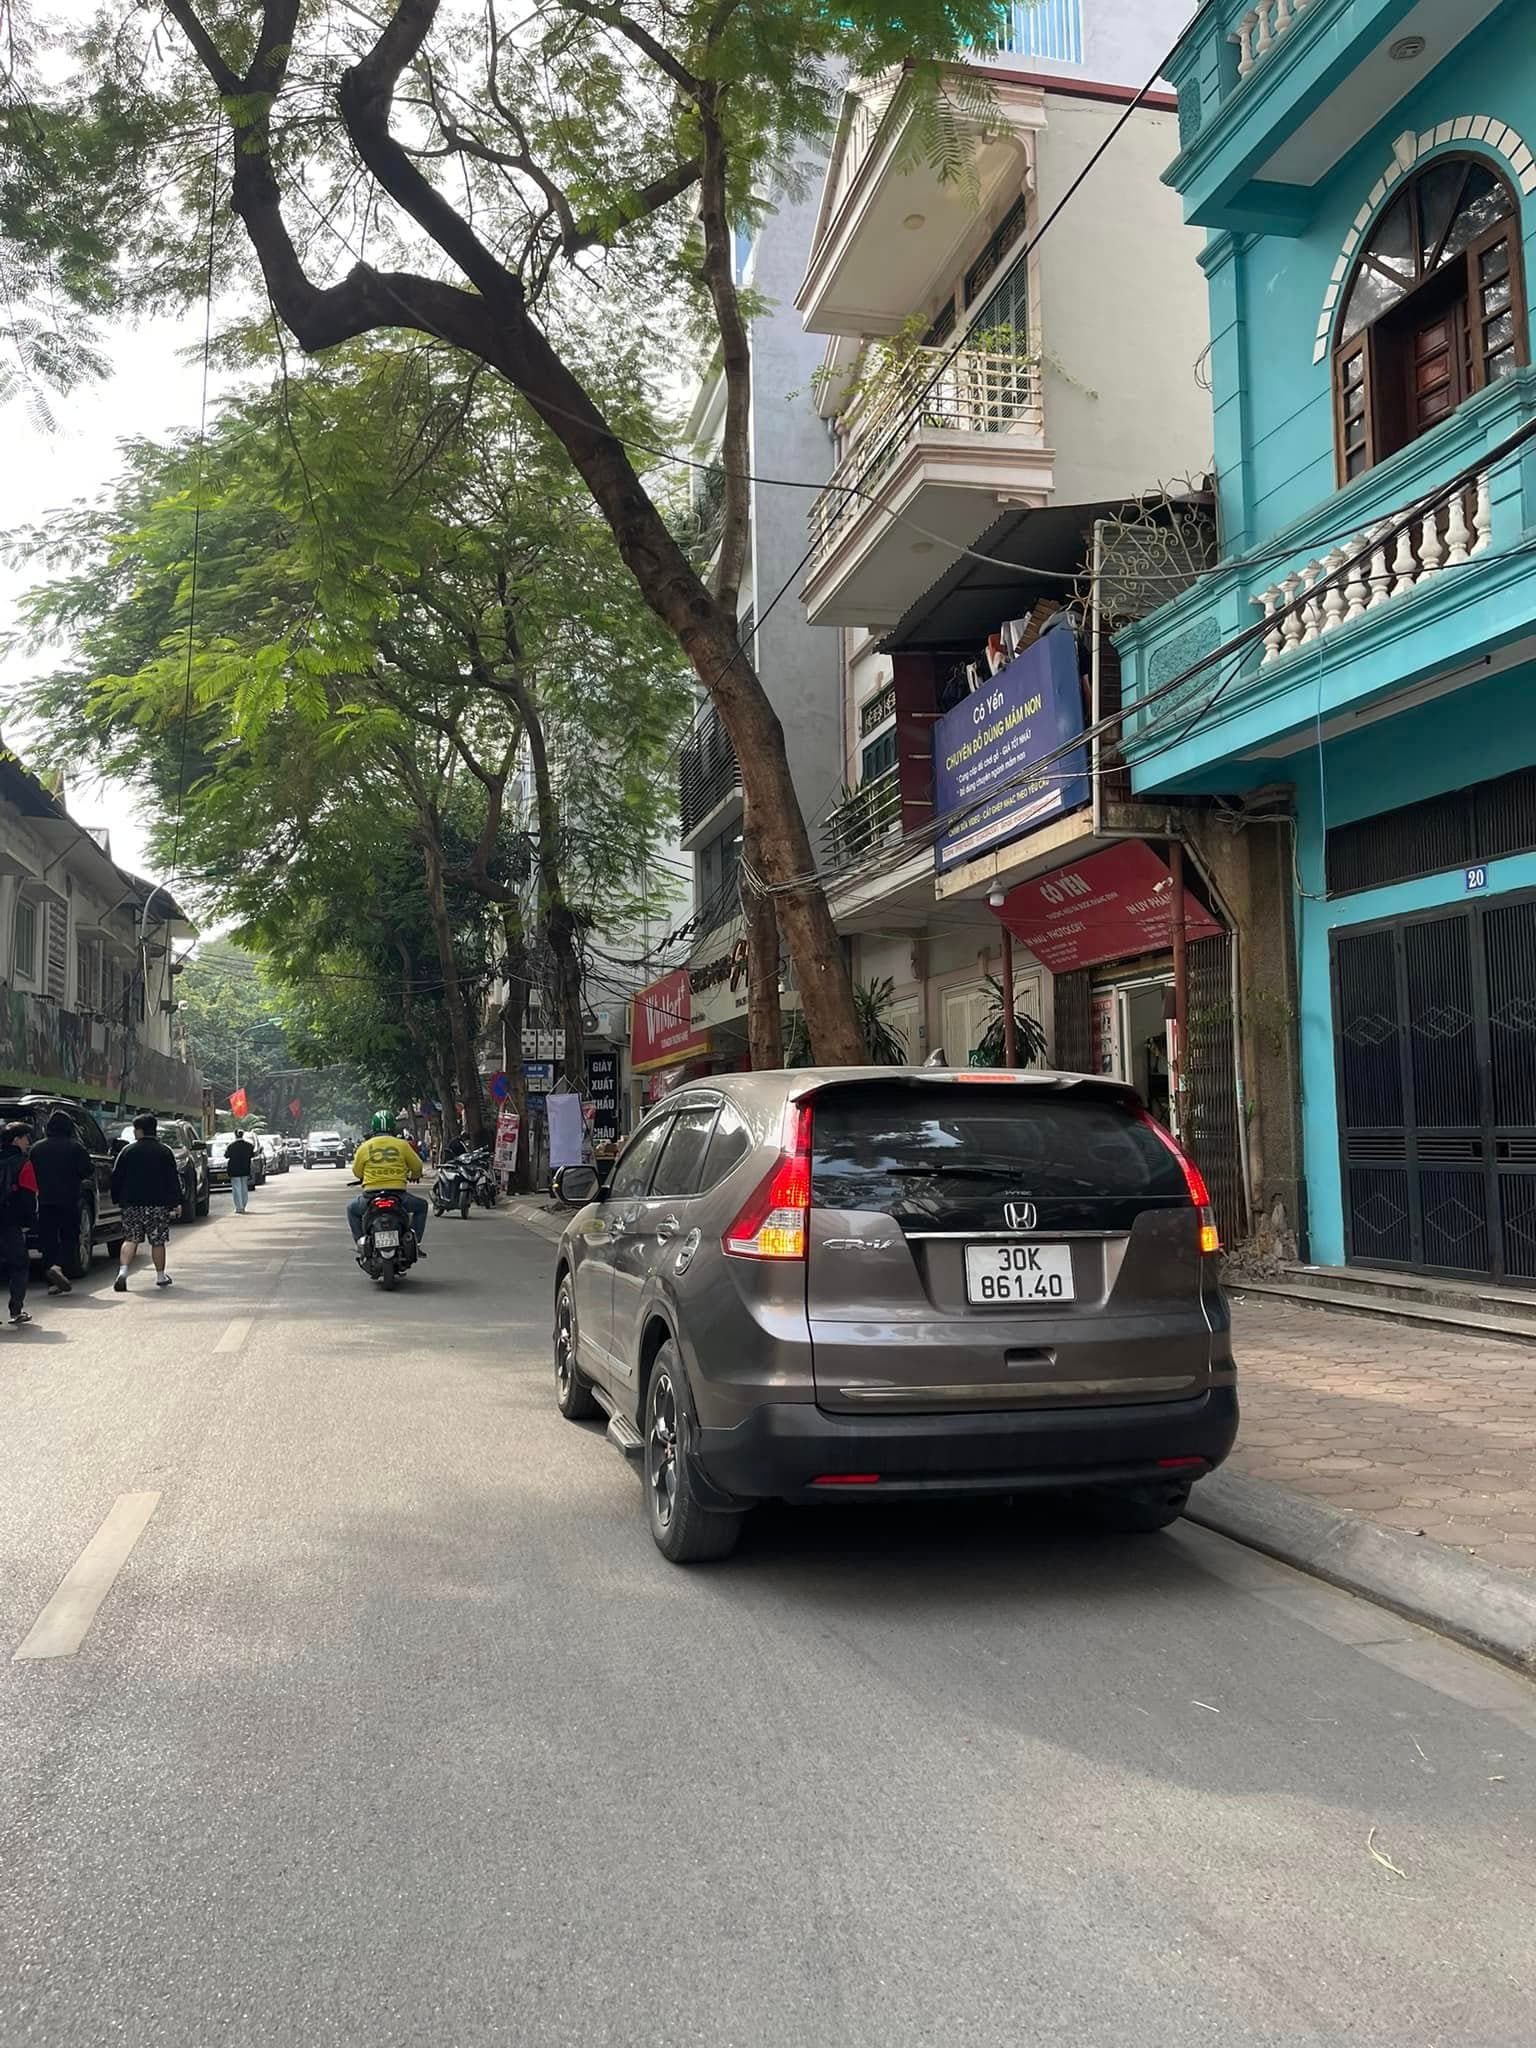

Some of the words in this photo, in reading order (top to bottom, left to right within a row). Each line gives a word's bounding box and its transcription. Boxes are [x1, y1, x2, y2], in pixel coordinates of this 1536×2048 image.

[987, 688, 1004, 714] Yến
[946, 743, 973, 771] CHUYÊN
[983, 720, 1004, 746] DÙNG
[1005, 704, 1024, 732] MẦM
[1024, 693, 1042, 718] NON
[1468, 869, 1484, 888] 20
[1040, 880, 1065, 904] CÔ
[591, 1076, 614, 1090] XUẤT
[368, 1144, 400, 1164] be
[998, 1247, 1042, 1271] 30K
[981, 1273, 1063, 1299] 861.40
